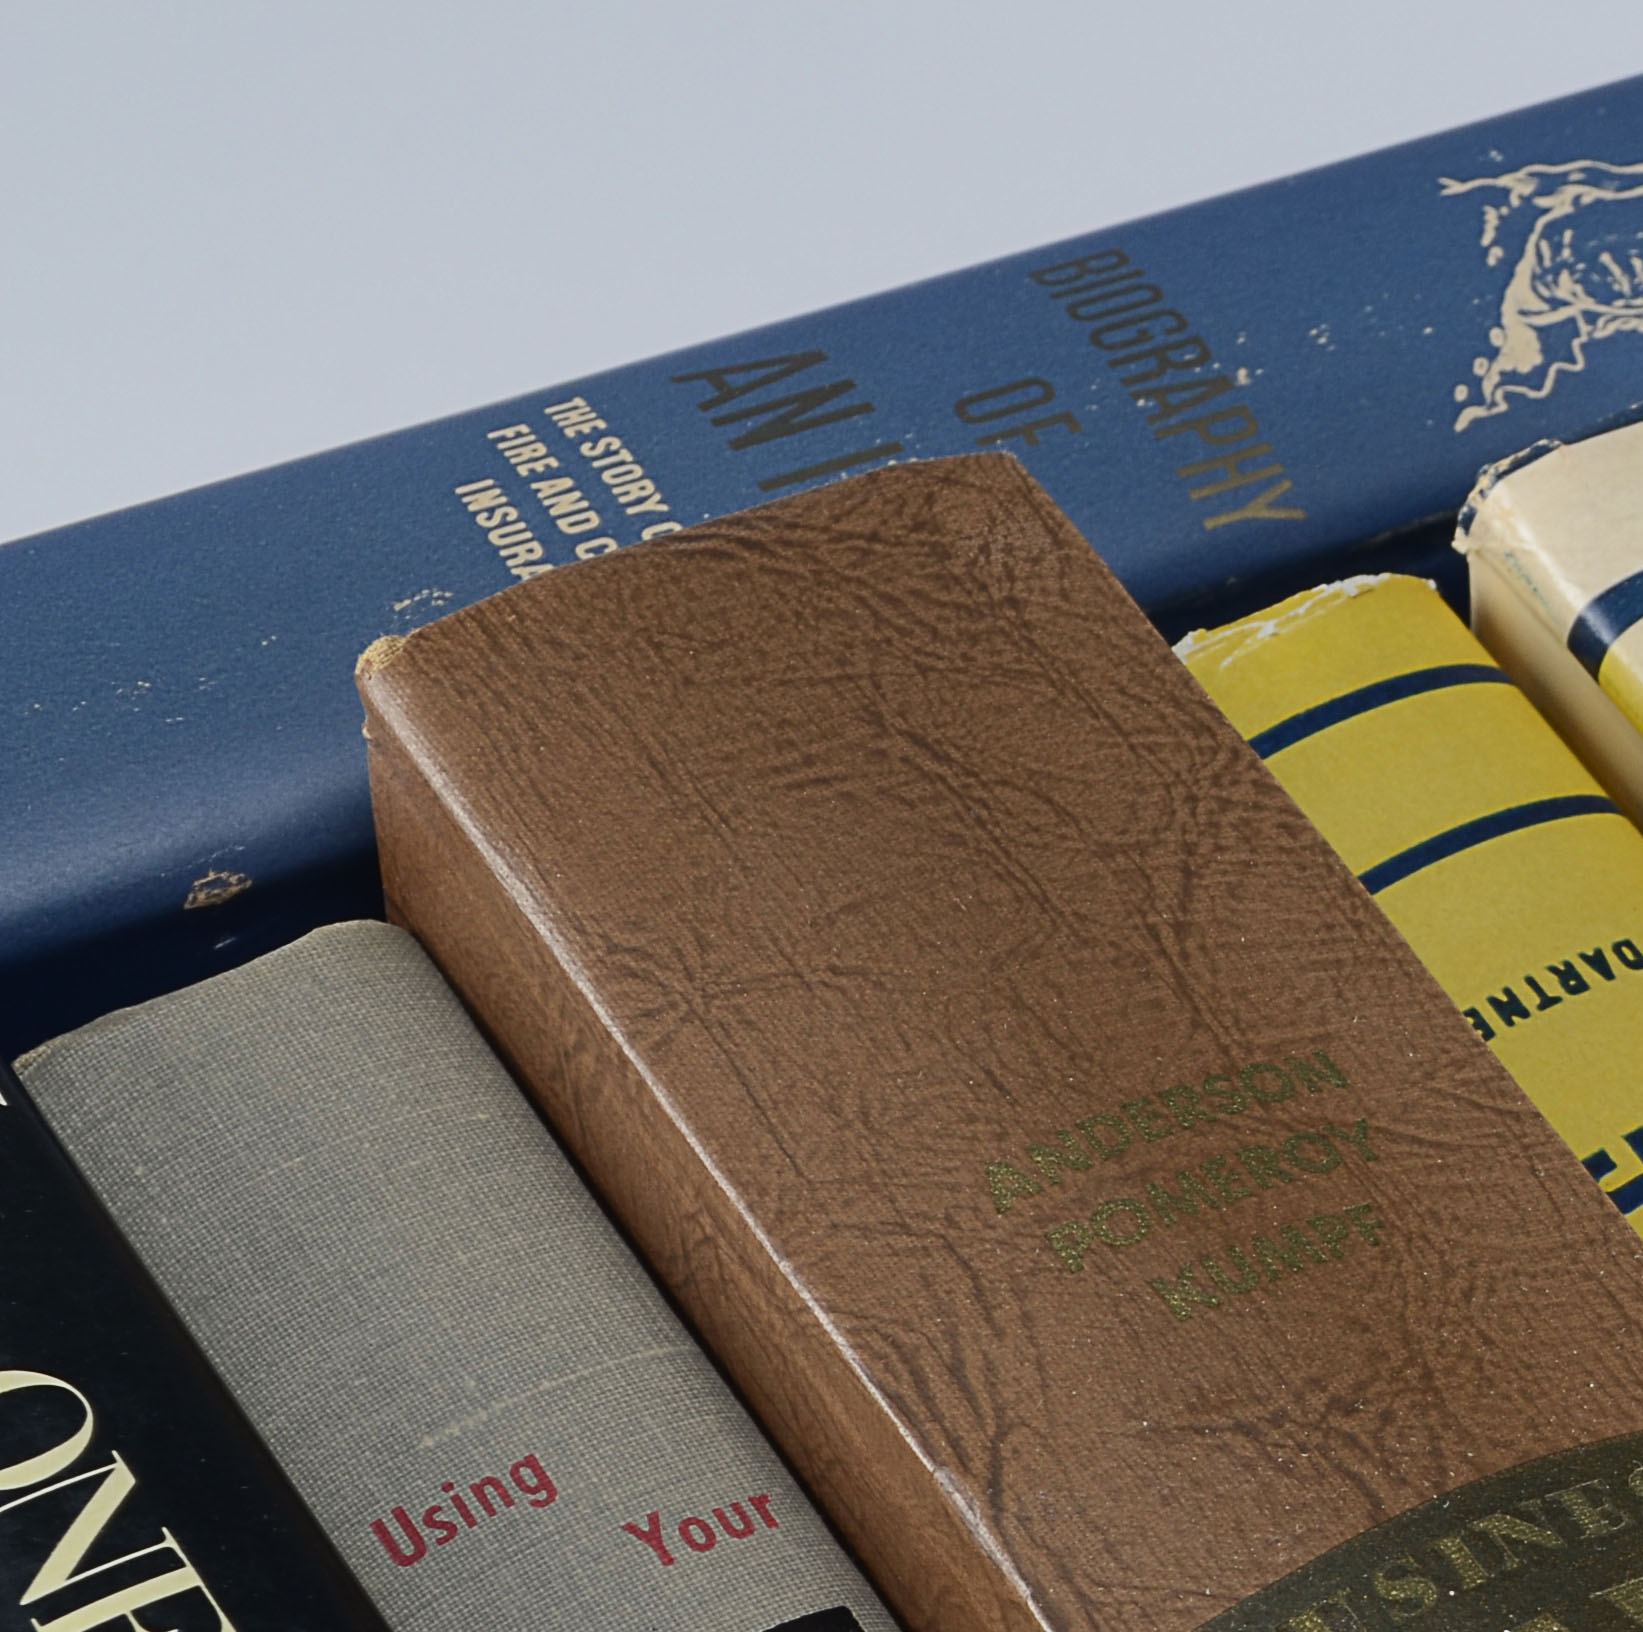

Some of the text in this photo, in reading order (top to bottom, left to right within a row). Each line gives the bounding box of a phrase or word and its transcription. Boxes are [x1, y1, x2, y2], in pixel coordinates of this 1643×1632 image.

[670, 348, 877, 452] AN
[950, 375, 1083, 452] OF
[1028, 247, 1307, 531] BIOGRAPHY
[487, 423, 559, 477] FIRE
[530, 476, 600, 535] AND
[544, 396, 607, 438] THE
[580, 436, 669, 515] STORY
[985, 1050, 1349, 1214] ANDERSON
[1045, 1117, 1379, 1274] POMEROY
[1152, 1203, 1386, 1322] KUMPF
[369, 1453, 781, 1569] Using Your
